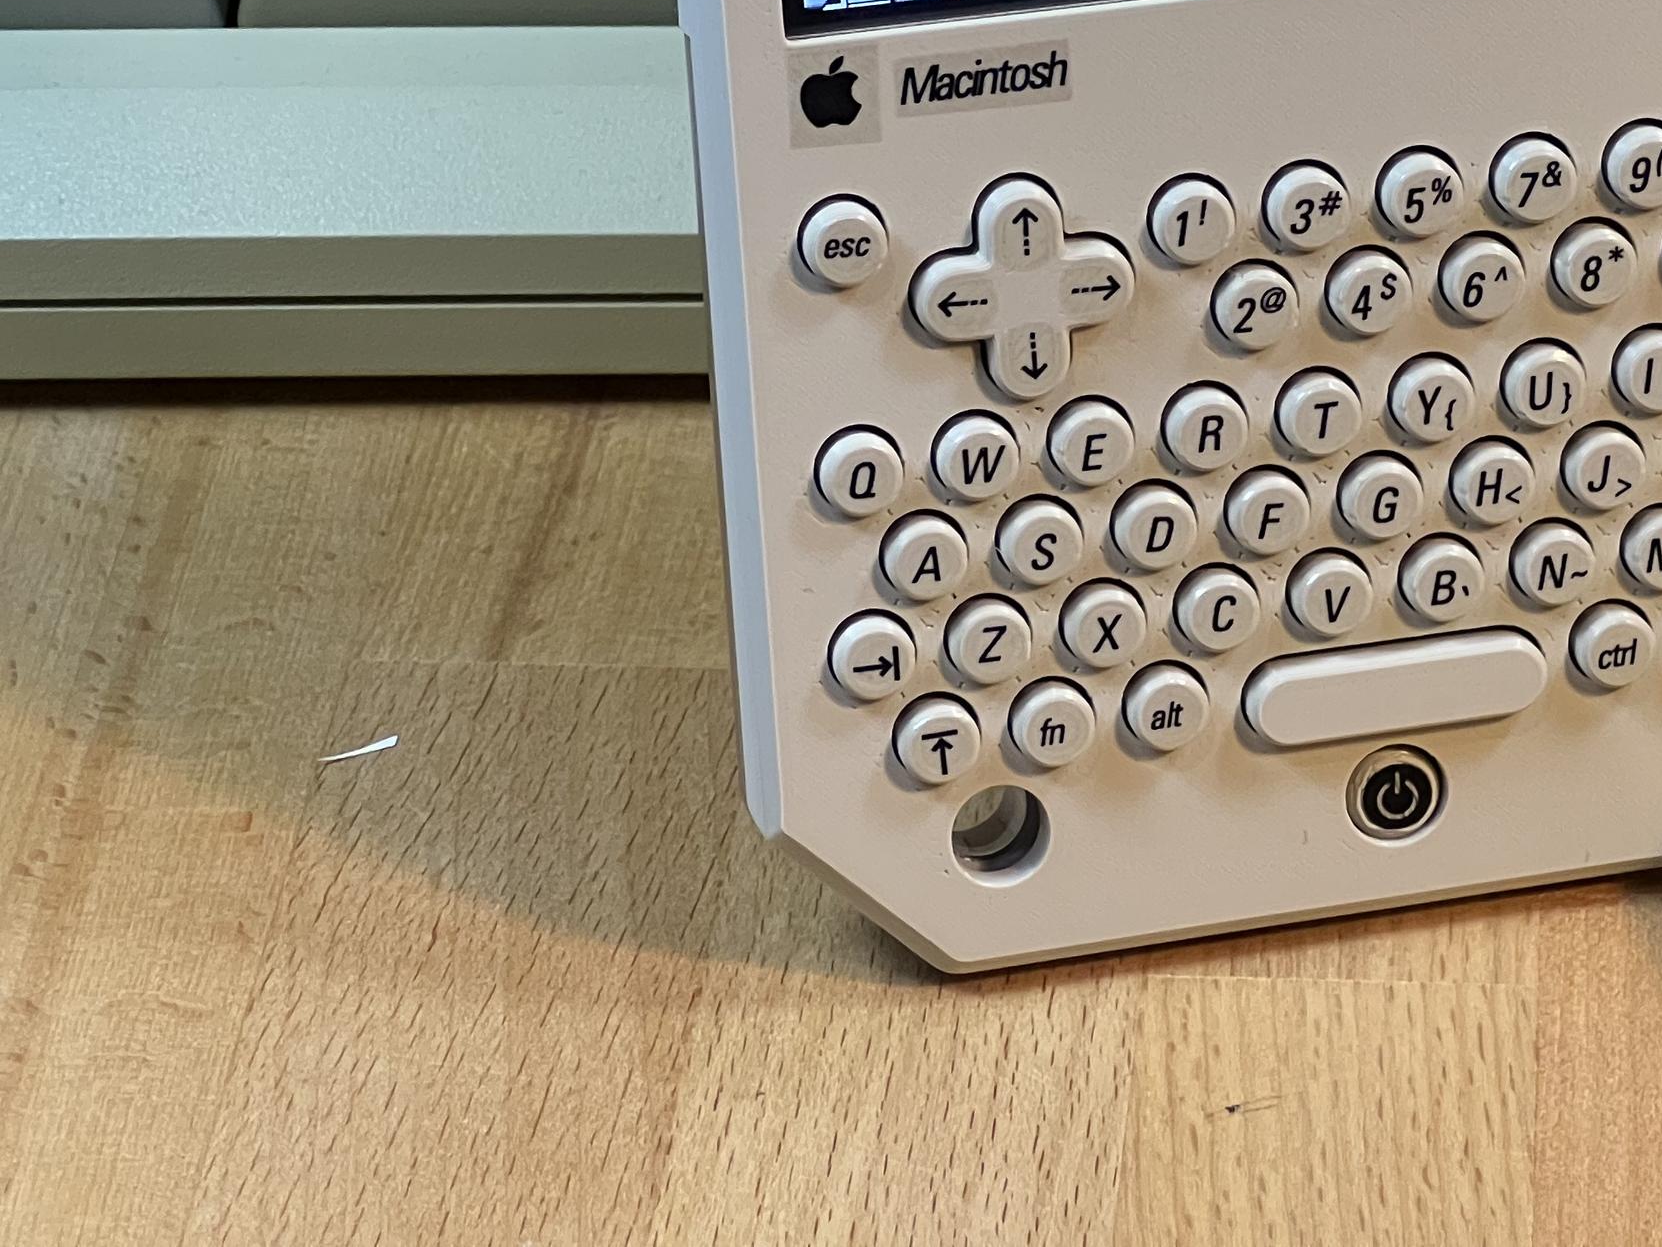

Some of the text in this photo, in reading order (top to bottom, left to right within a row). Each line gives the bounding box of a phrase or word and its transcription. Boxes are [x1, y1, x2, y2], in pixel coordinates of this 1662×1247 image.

[900, 51, 1068, 105] Macintosh
[823, 236, 872, 260] esc
[1197, 414, 1225, 454] R
[1313, 400, 1340, 440] T
[961, 444, 1006, 485] W
[1081, 433, 1108, 472] E
[848, 461, 877, 500] Q
[1257, 502, 1285, 540] F
[1372, 486, 1400, 524] G
[1030, 532, 1058, 571] S
[1145, 516, 1175, 553] D
[911, 545, 942, 584] A
[1211, 594, 1237, 633] C
[1324, 585, 1351, 624] V
[978, 624, 1008, 664] Z
[1092, 613, 1123, 654] X
[1597, 637, 1638, 670] ctrl
[1039, 717, 1066, 748] fn
[1150, 700, 1184, 731] alt
